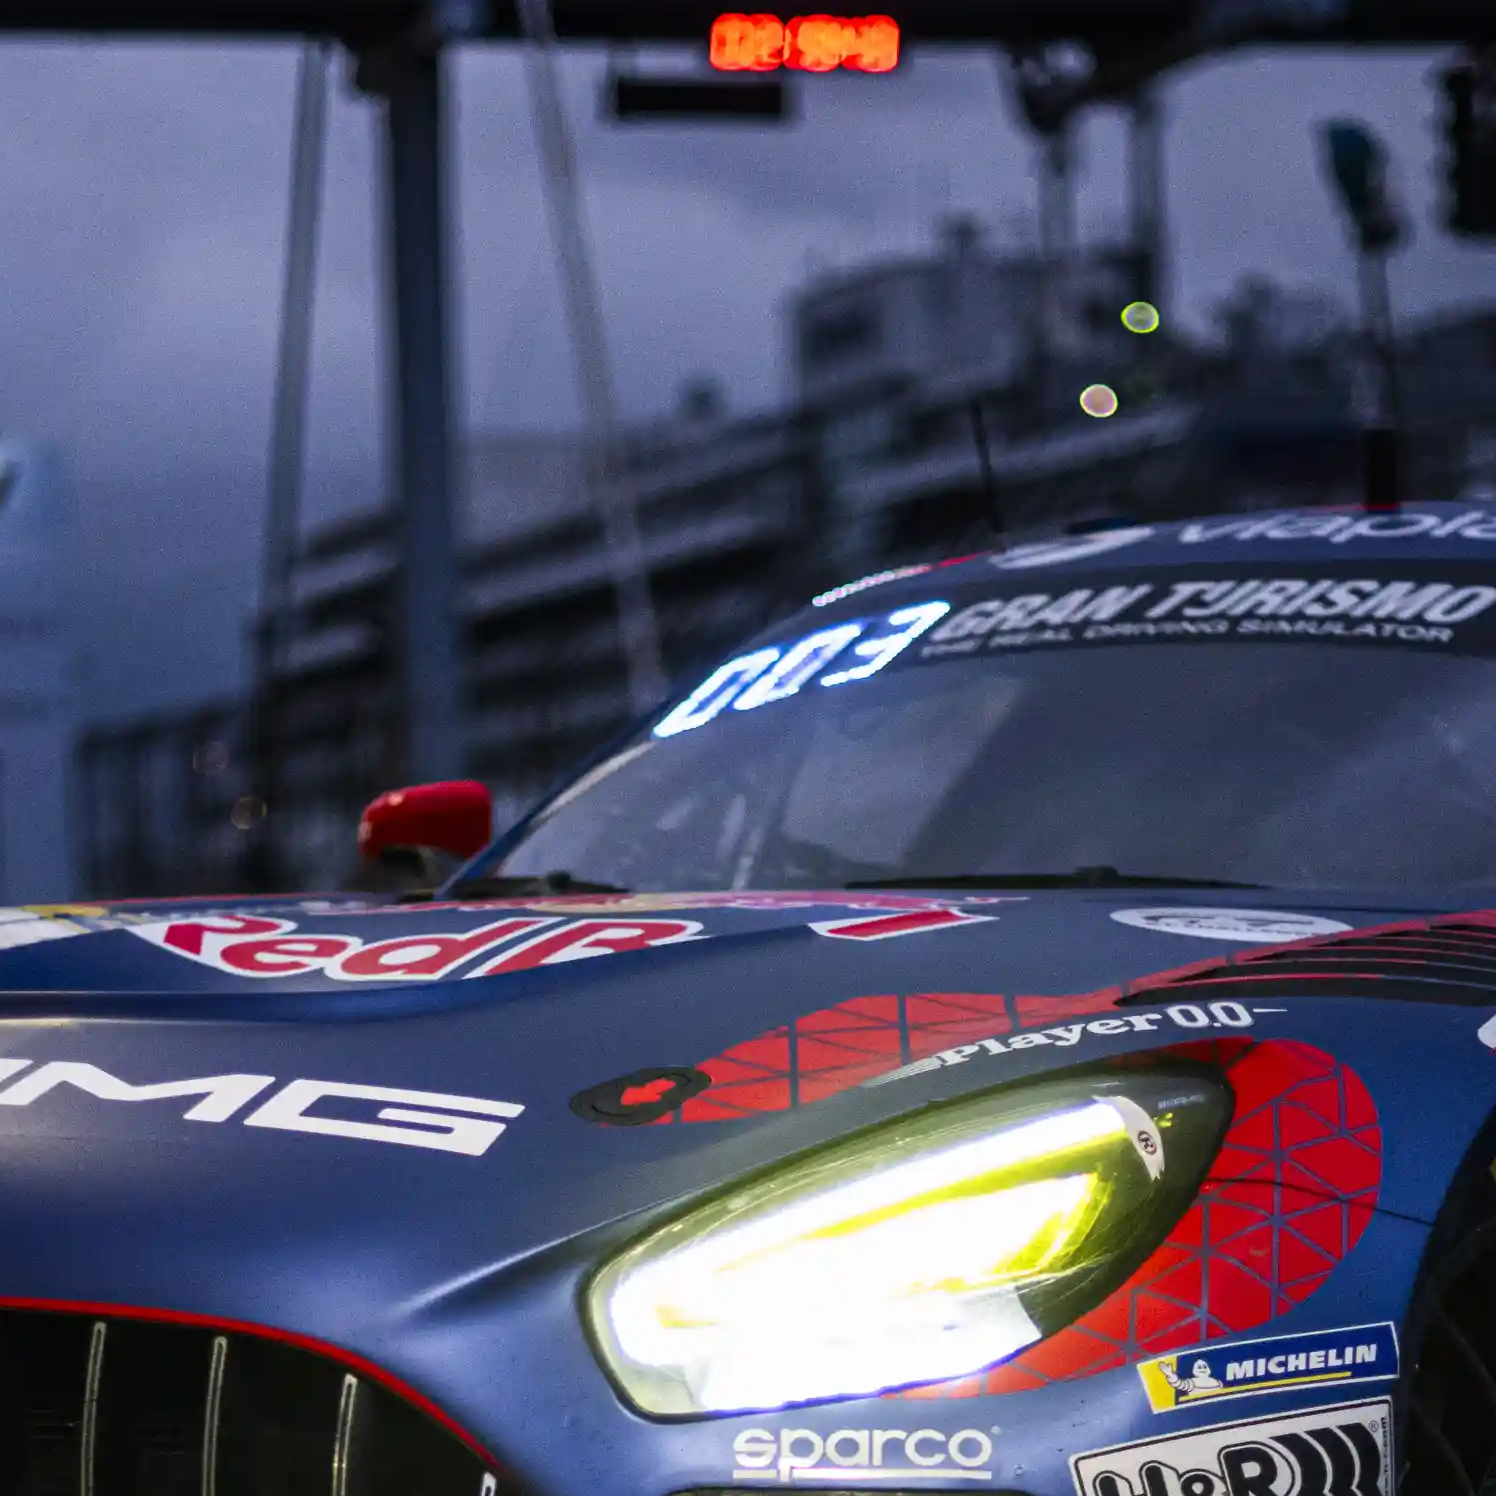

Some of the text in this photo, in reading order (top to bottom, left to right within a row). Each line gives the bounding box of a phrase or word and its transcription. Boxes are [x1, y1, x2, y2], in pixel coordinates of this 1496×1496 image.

[928, 583, 1155, 643] GRAN
[987, 627, 1074, 649] REAL
[1082, 619, 1230, 641] DRIVING
[1235, 618, 1455, 644] SIMULATOR
[653, 600, 951, 739] 003
[934, 1011, 1163, 1069] Player
[1224, 1341, 1378, 1381] MICHELIN
[733, 1427, 993, 1481] sparco
